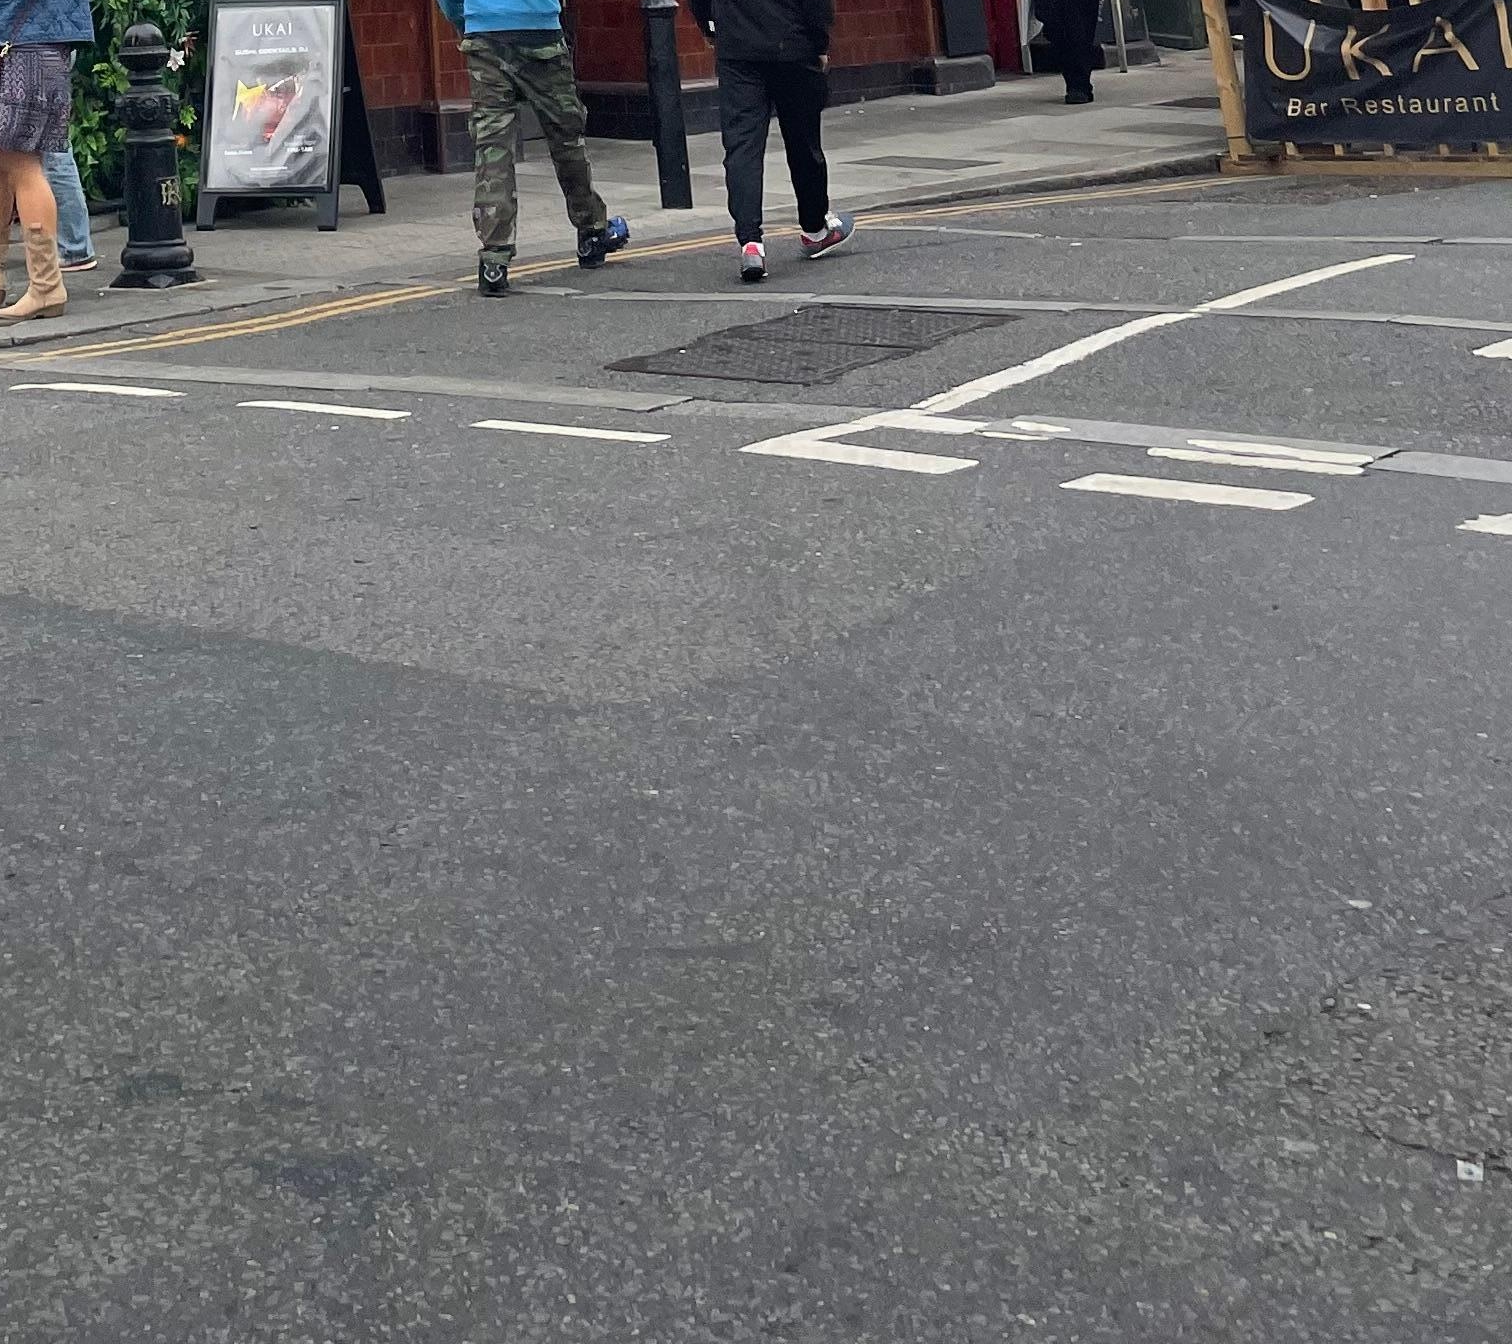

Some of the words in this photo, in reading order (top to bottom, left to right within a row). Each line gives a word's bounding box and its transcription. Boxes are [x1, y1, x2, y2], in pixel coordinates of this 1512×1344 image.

[252, 22, 292, 37] UKAI
[1263, 0, 1512, 81] UKAI
[1287, 97, 1328, 117] Bar
[1340, 92, 1501, 115] Restaurant
